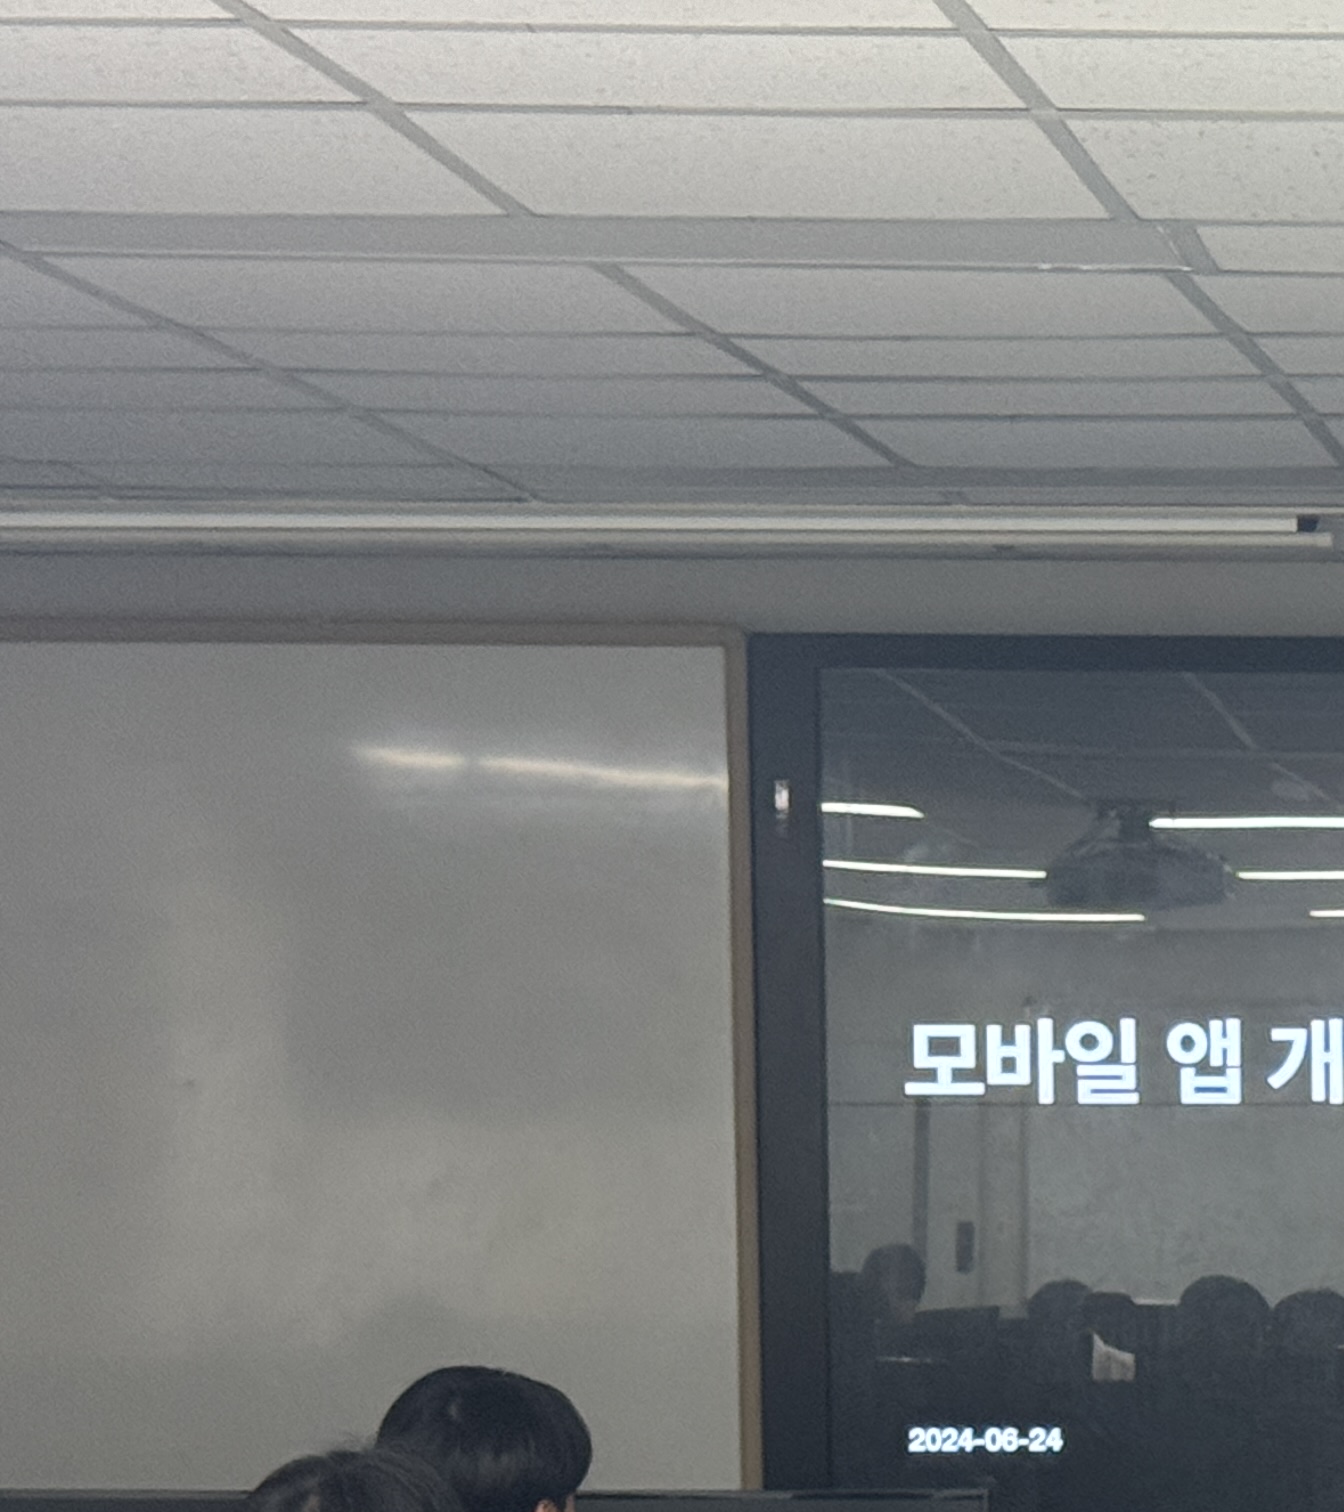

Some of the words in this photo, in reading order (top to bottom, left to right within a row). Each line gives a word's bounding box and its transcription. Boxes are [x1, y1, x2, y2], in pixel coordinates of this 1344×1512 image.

[904, 1017, 1140, 1105] 모바일
[1166, 1016, 1242, 1105] 앱
[907, 1426, 1064, 1453] 2024-06-24
